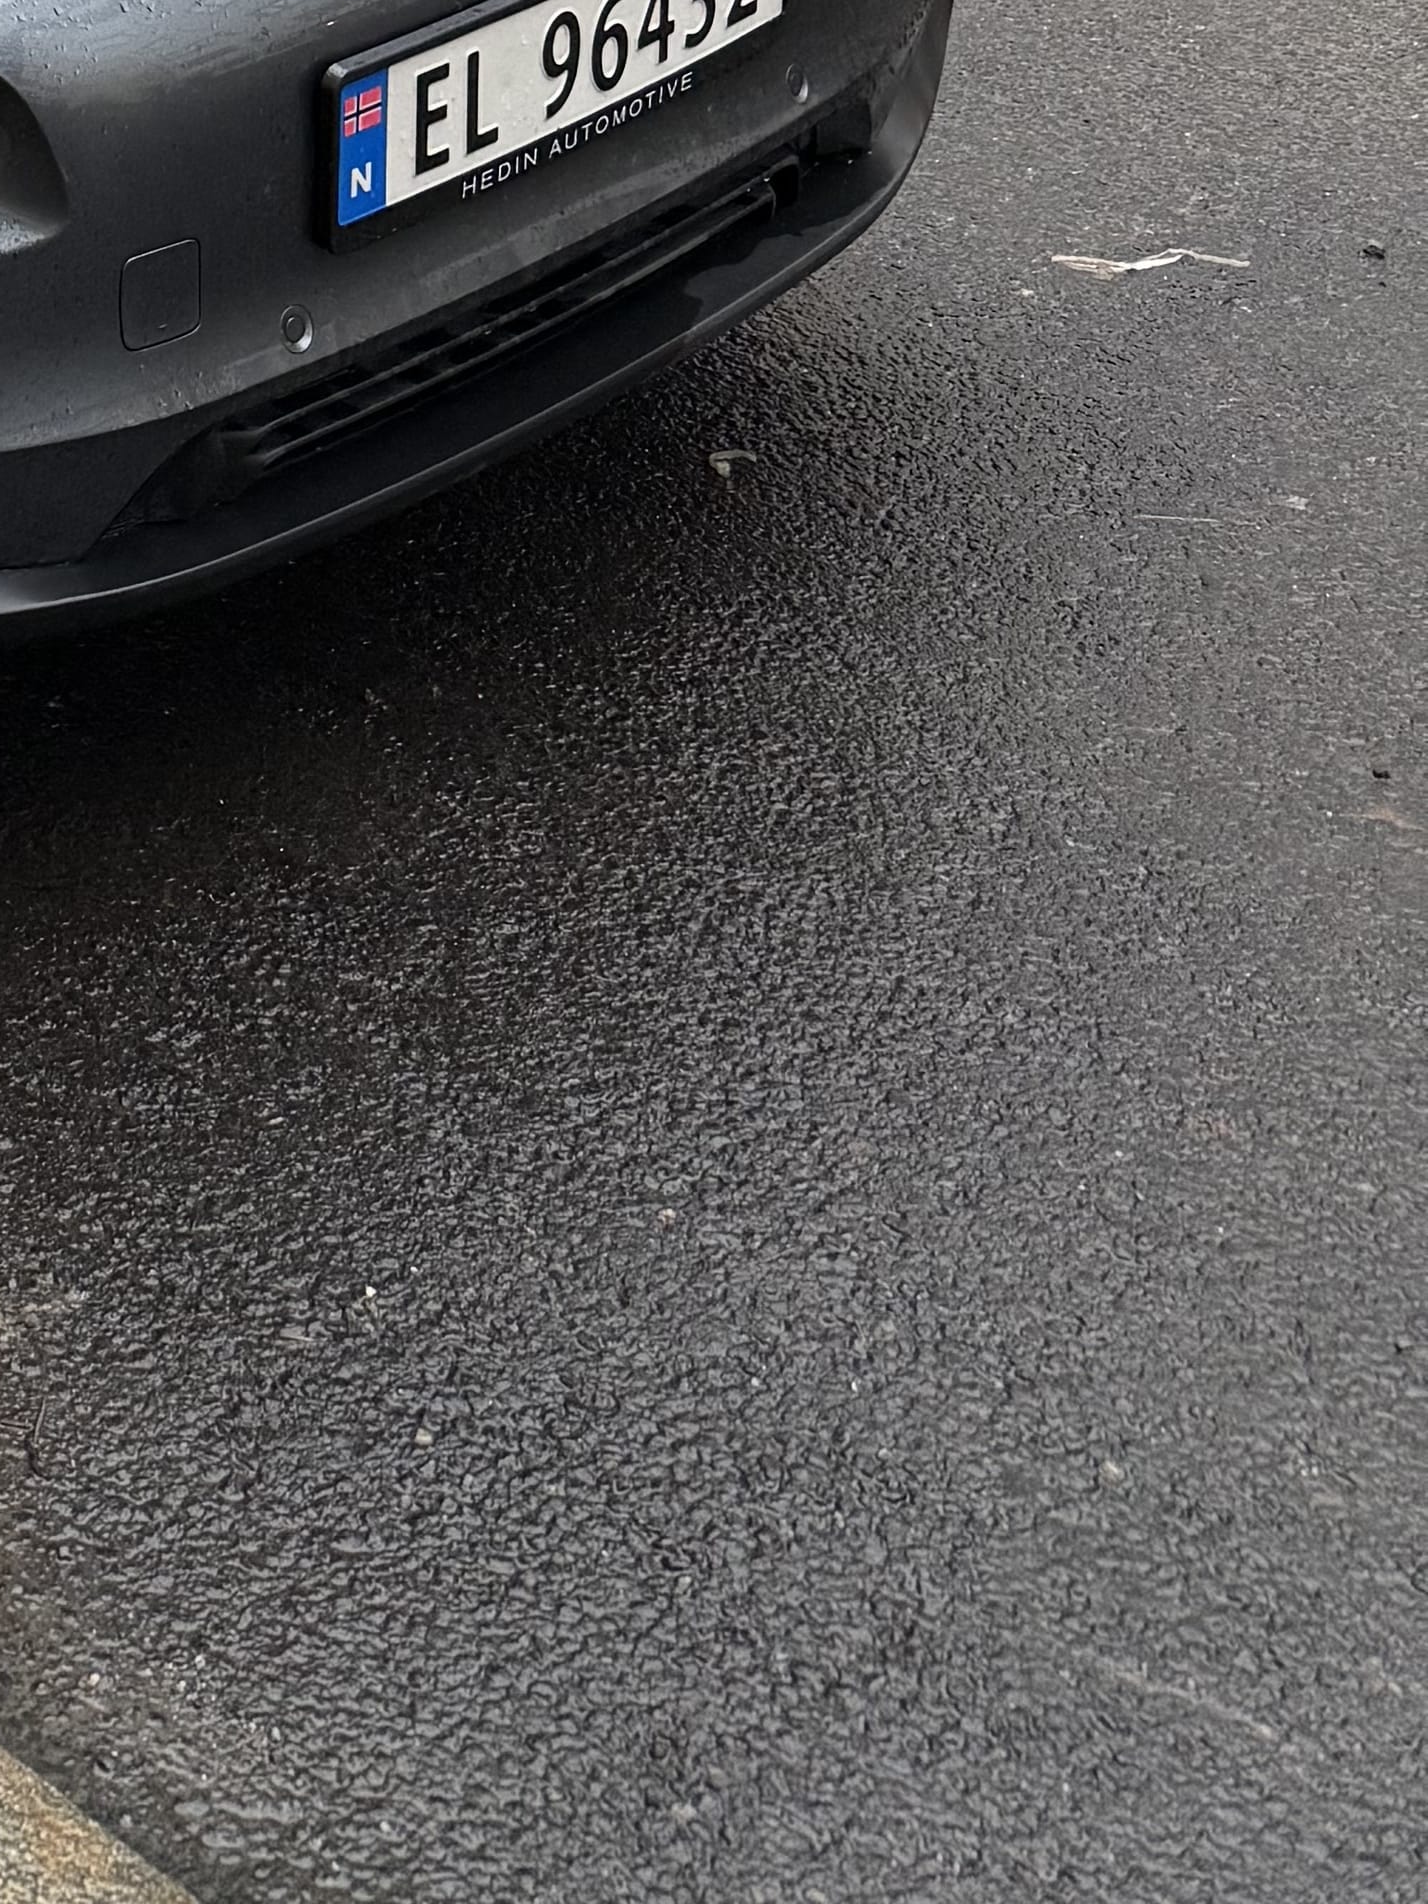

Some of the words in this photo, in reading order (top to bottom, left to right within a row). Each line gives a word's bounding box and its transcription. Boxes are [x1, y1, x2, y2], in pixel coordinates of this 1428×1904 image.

[414, 50, 499, 177] EL
[461, 147, 539, 199] HEDIN
[548, 71, 694, 159] AUTOMOTIVE
[350, 160, 373, 199] N
